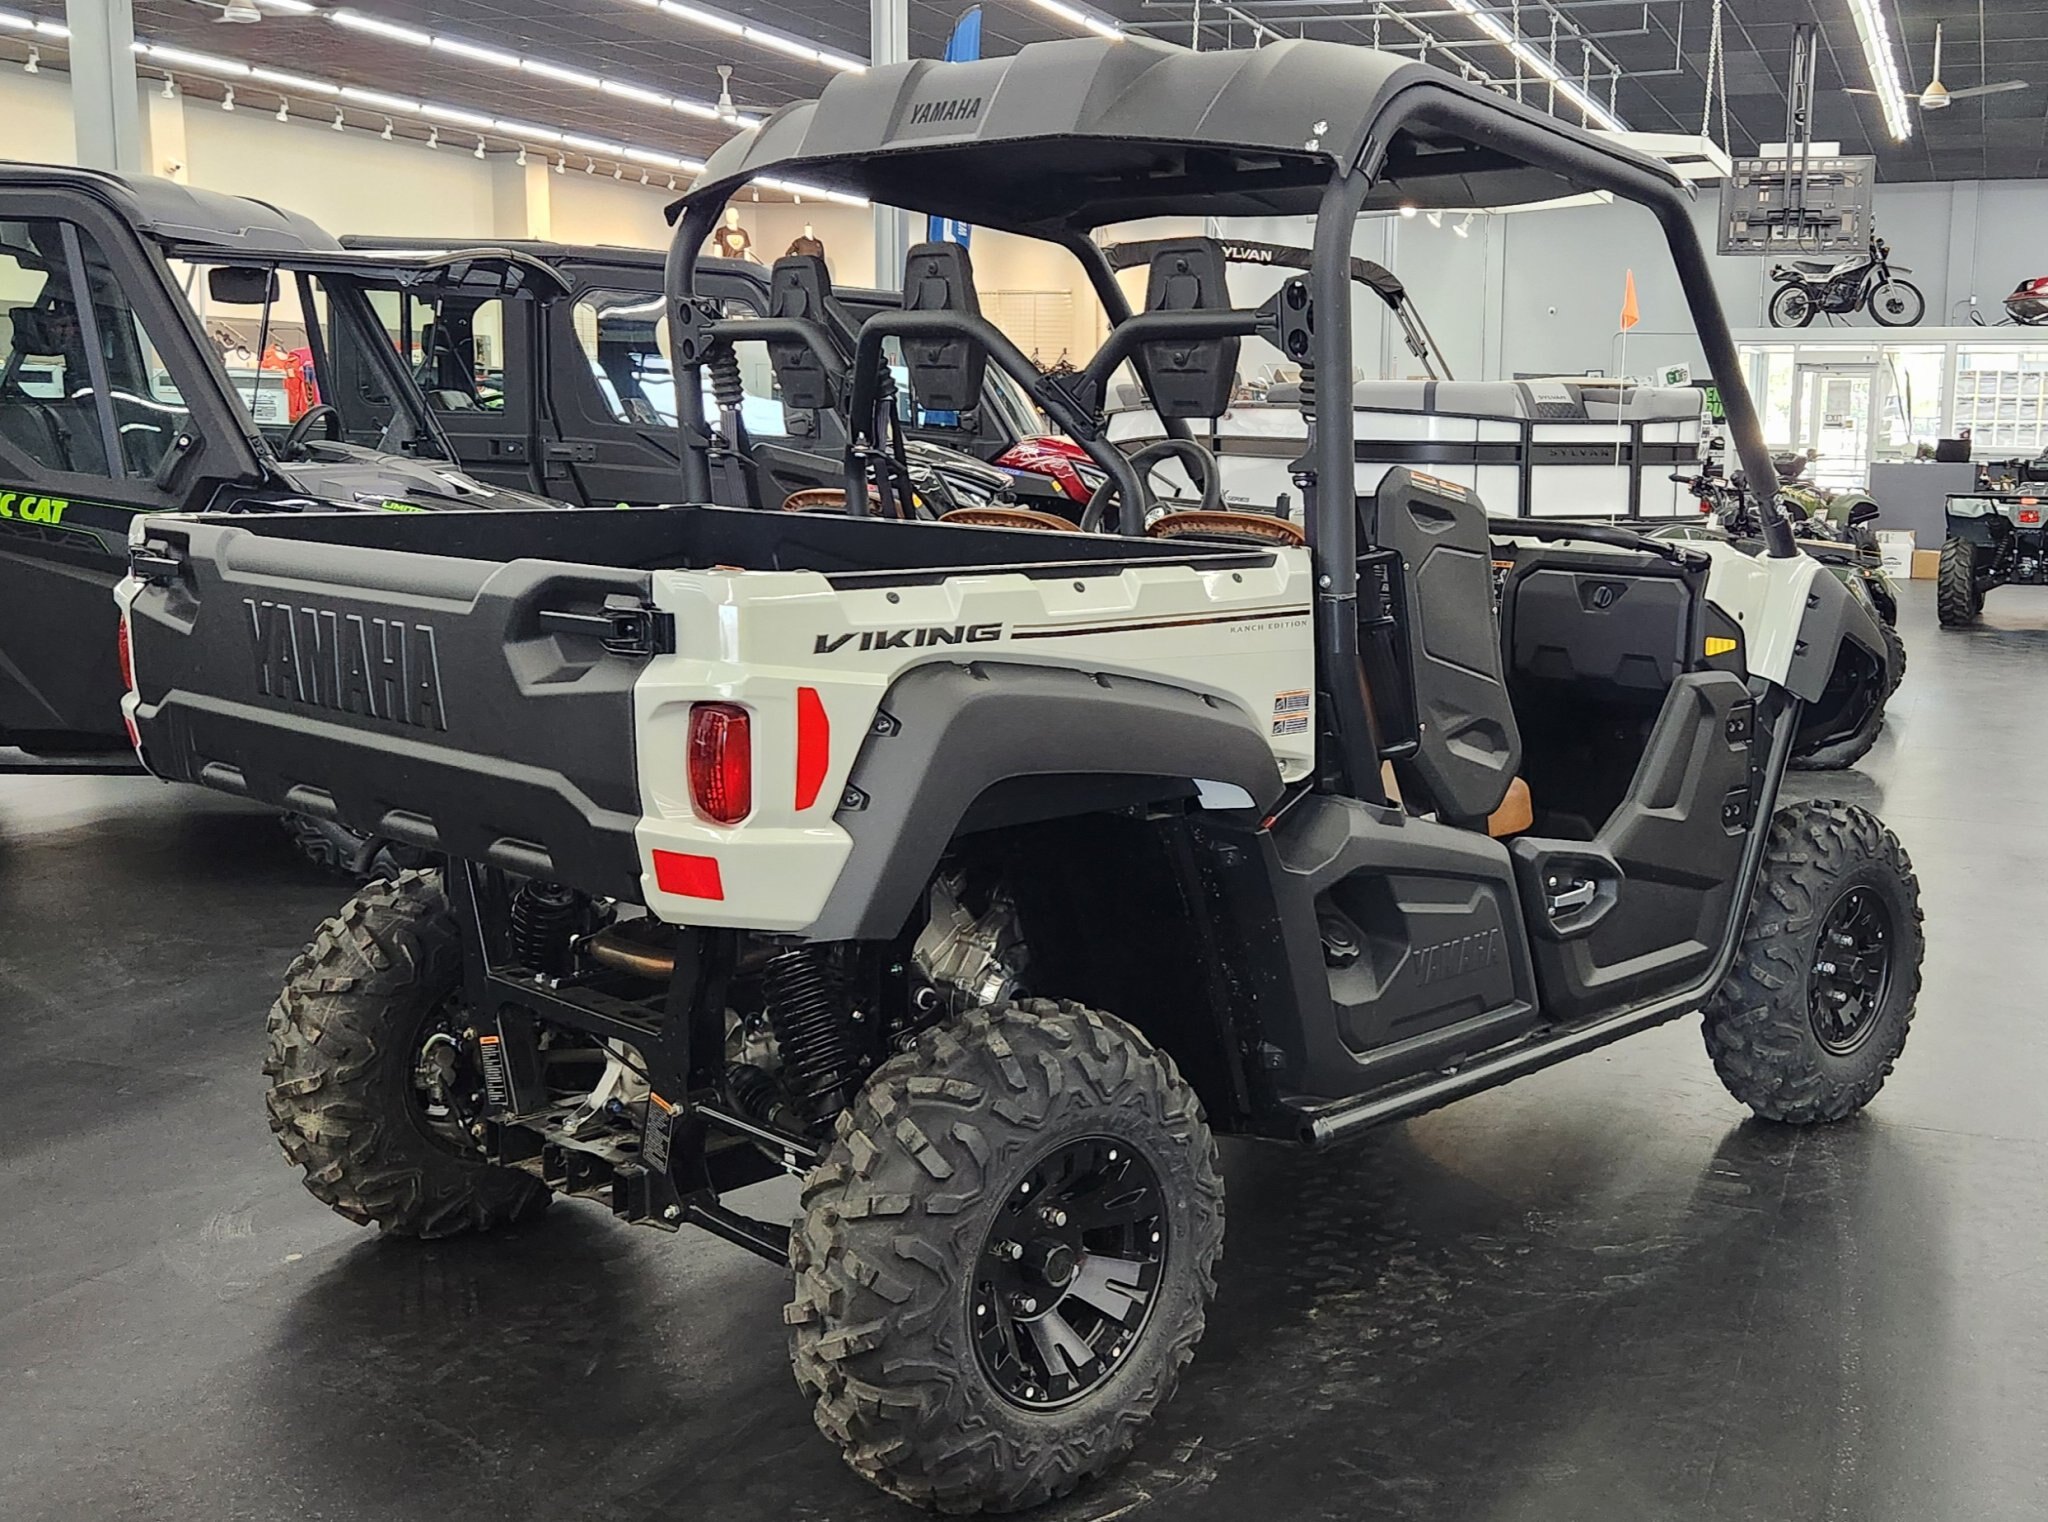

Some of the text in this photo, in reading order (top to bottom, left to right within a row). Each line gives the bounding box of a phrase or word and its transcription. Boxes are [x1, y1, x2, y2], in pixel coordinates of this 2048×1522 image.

[910, 97, 981, 124] YAMAHA
[1220, 246, 1272, 261] YLVAN
[1548, 448, 1610, 457] SYLVAN
[0, 492, 69, 524] C CAT
[813, 622, 1003, 655] VIKING
[1230, 620, 1308, 633] RANCH EDITION
[242, 597, 448, 732] YAMAHA
